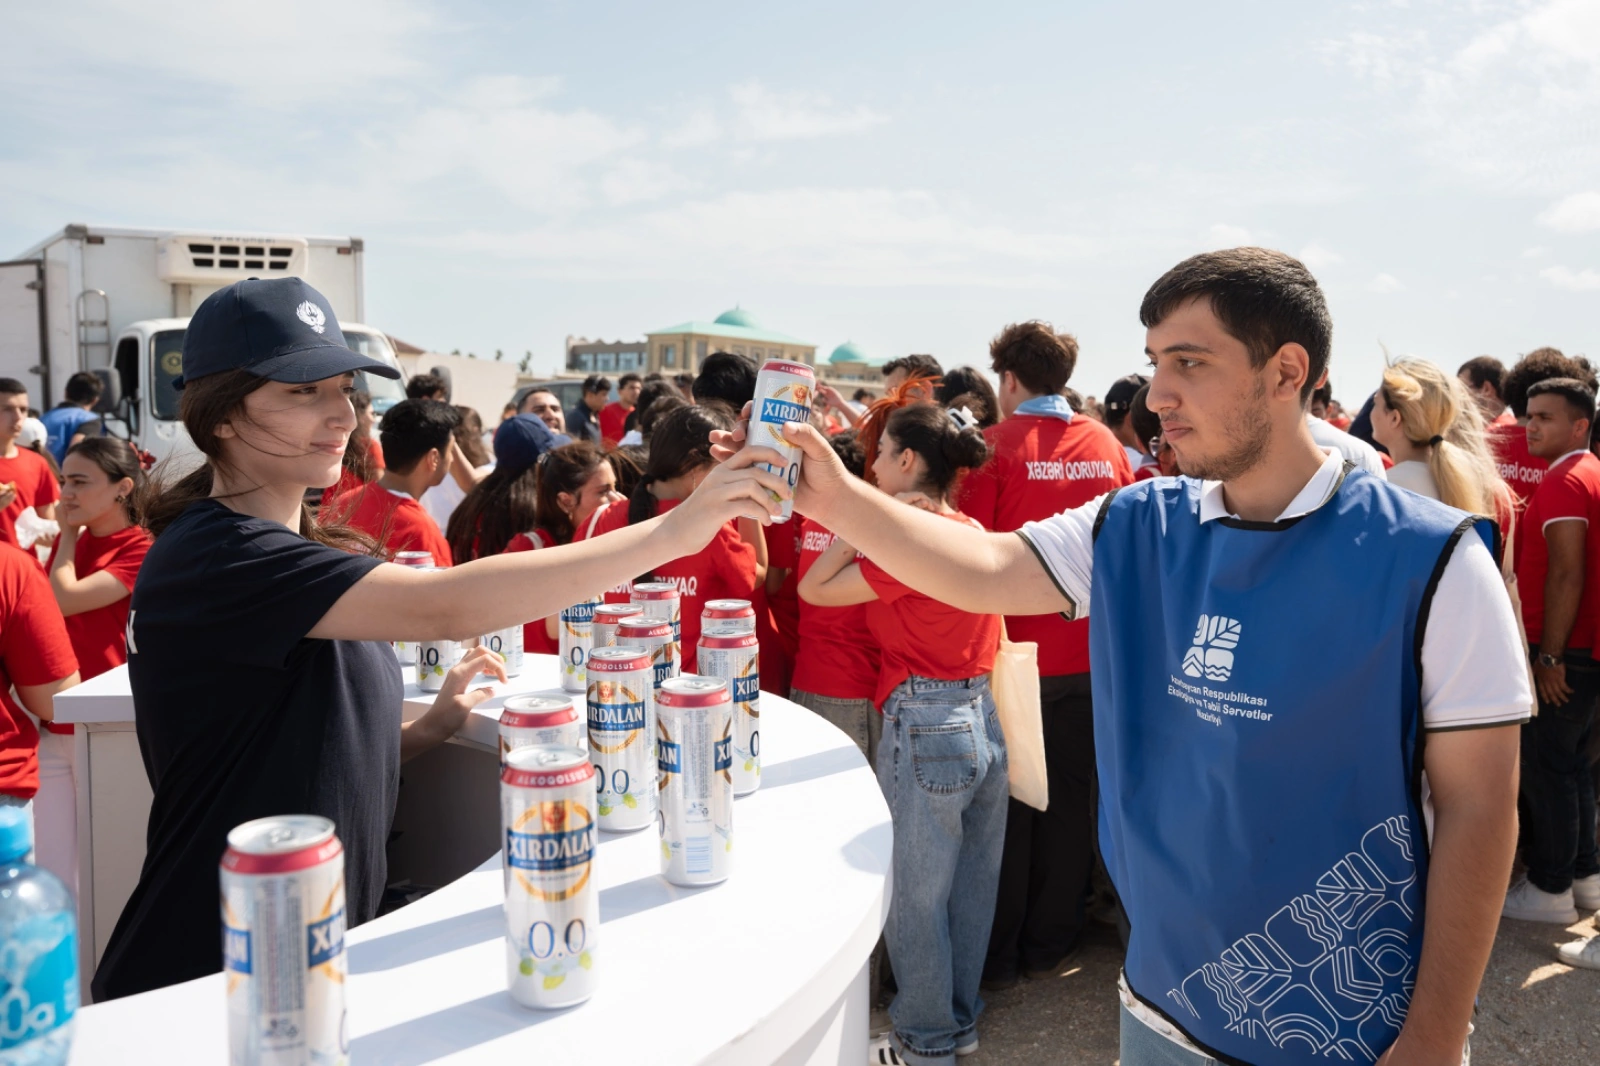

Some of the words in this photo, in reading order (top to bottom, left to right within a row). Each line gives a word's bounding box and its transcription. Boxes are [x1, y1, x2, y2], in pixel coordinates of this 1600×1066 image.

[763, 402, 810, 423] XIRDAL
[1065, 460, 1114, 480] QORUYAQ
[1203, 686, 1267, 707] Respublikası
[588, 706, 643, 724] IRDALAN
[1223, 704, 1273, 722] Sərvətlər
[528, 919, 586, 959] 0.0
